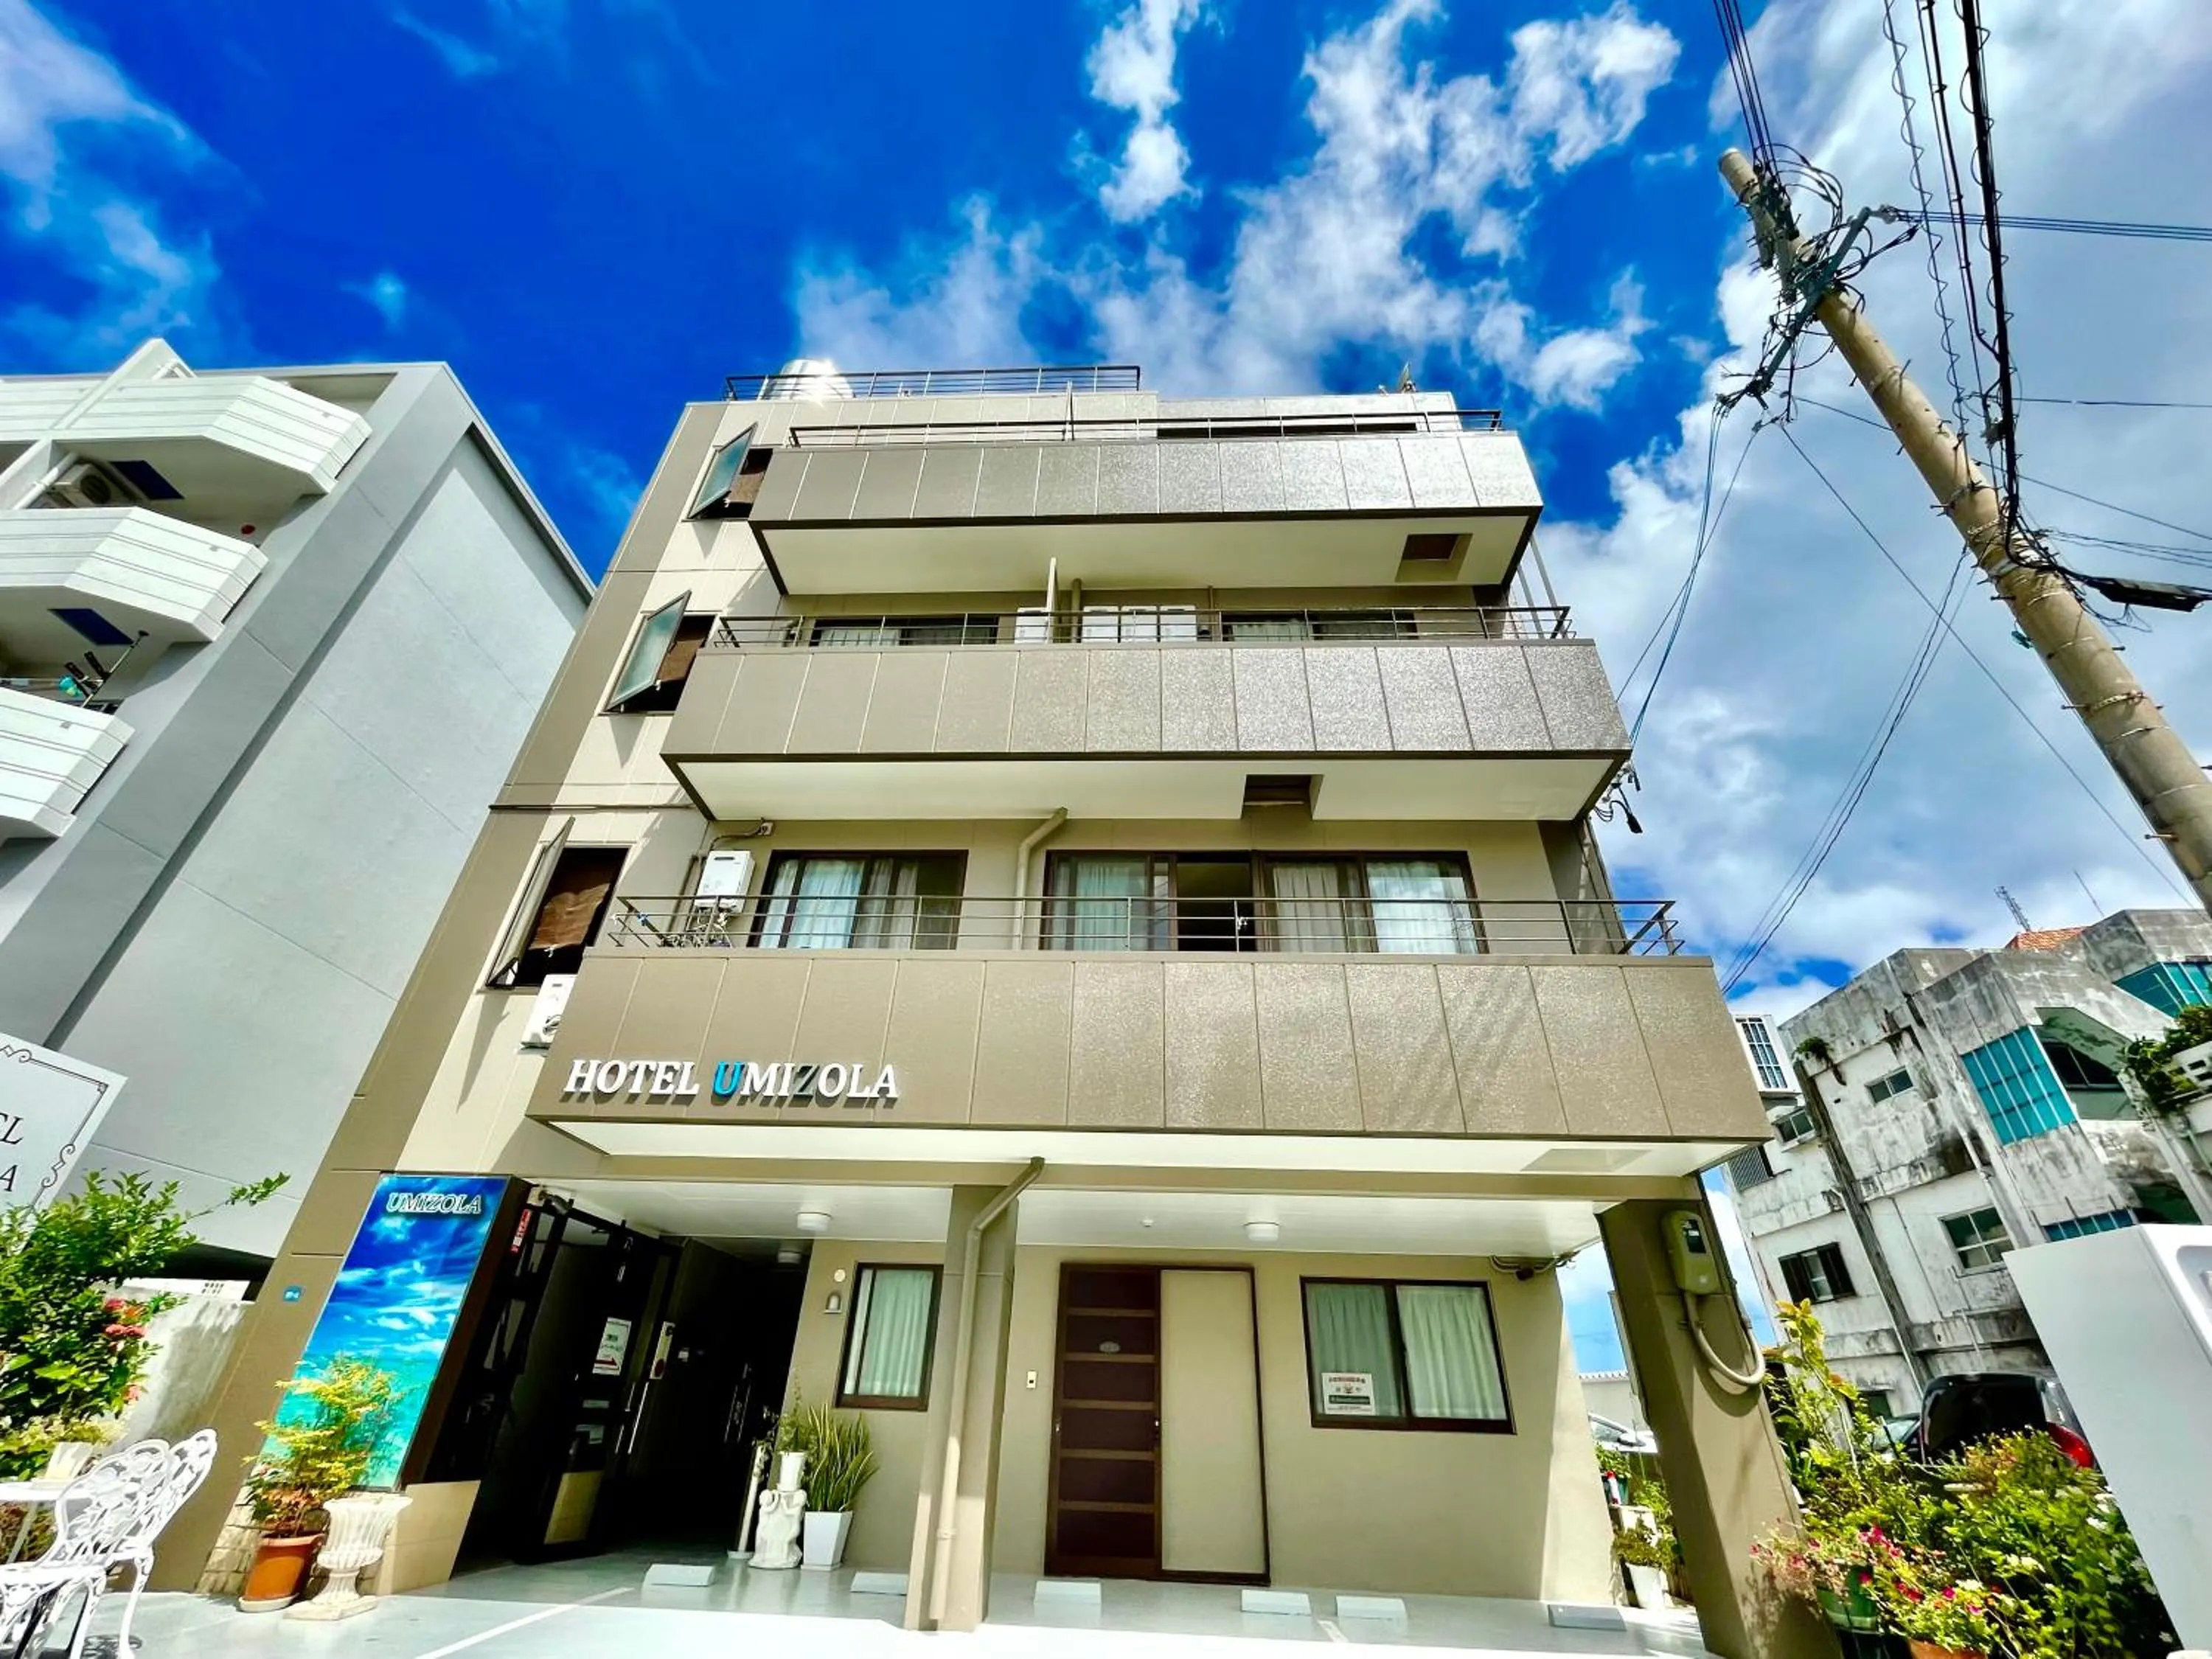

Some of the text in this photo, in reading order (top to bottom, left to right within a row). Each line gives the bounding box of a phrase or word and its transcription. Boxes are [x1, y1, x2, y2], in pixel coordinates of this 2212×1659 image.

[563, 1060, 899, 1098] HOTEL UMIZOLA
[386, 1192, 481, 1214] UMIZOLA
